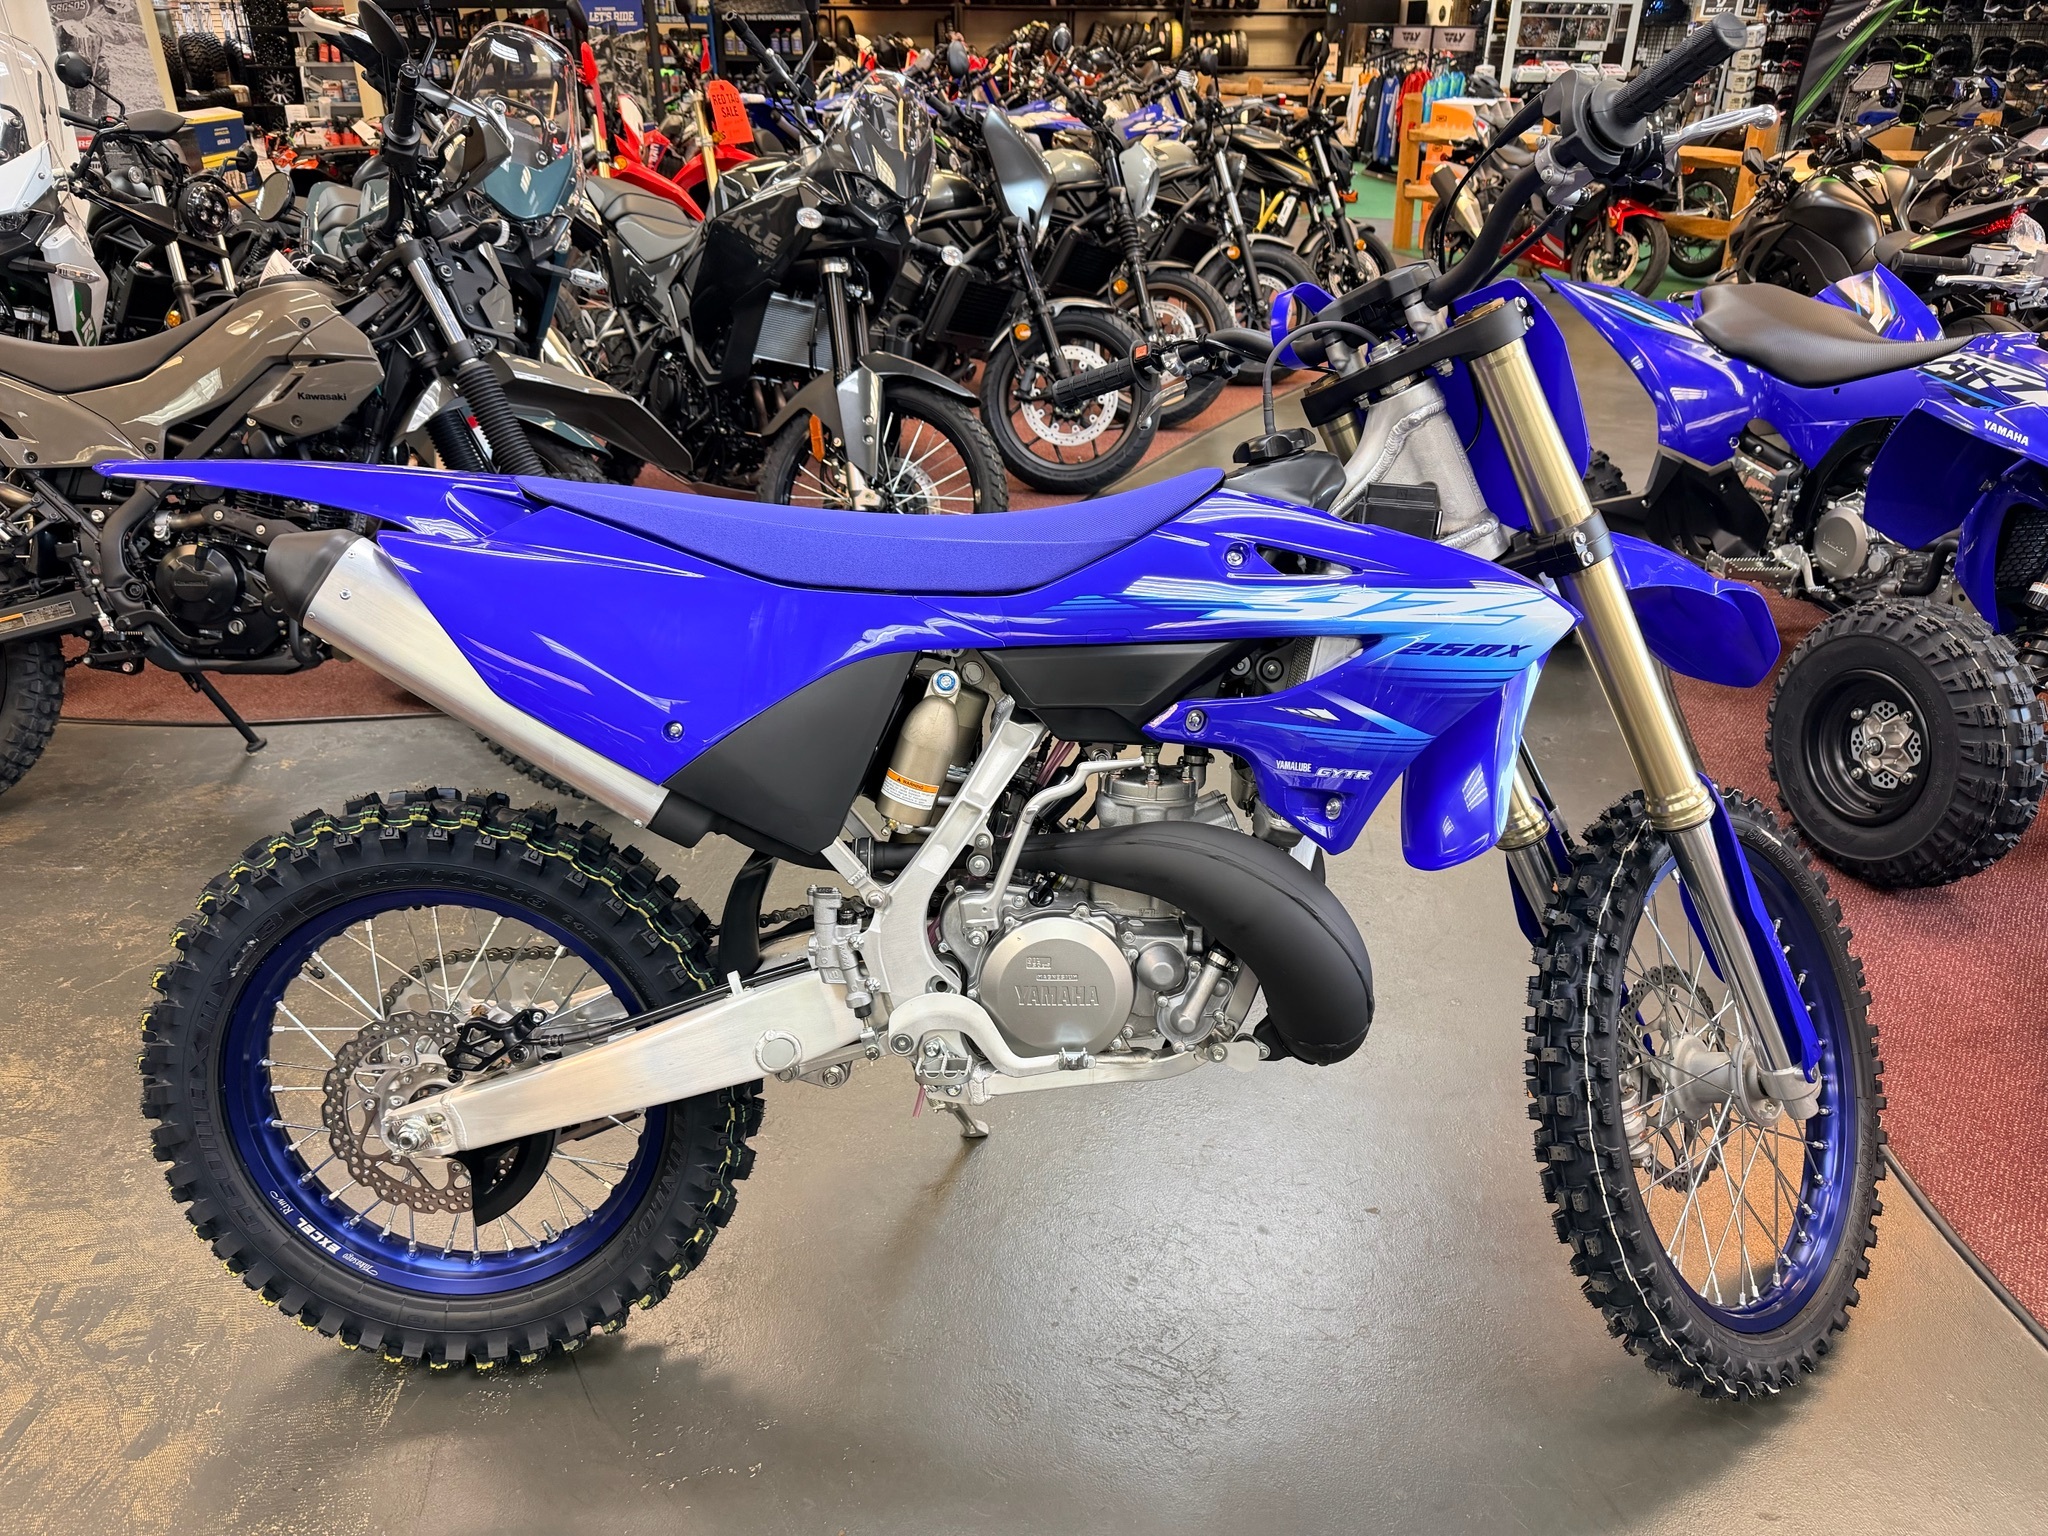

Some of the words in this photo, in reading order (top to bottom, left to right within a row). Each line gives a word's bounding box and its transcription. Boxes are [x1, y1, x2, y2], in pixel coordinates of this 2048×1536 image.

[589, 11, 612, 23] LET'S
[613, 11, 635, 22] RIDE
[712, 94, 727, 106] RED
[727, 93, 740, 104] TAG
[721, 106, 739, 118] SALE
[732, 214, 782, 251] KLE
[755, 244, 777, 259] 500
[297, 391, 347, 401] Kawasaki
[1984, 419, 2029, 446] YAMAHA
[1396, 642, 1533, 658] 250X
[1276, 759, 1312, 772] YAMALUBE
[1314, 767, 1373, 781] GYTR
[902, 779, 924, 790] WARNING
[1014, 985, 1099, 1006] YAMAHA
[296, 1217, 342, 1255] EXCEL
